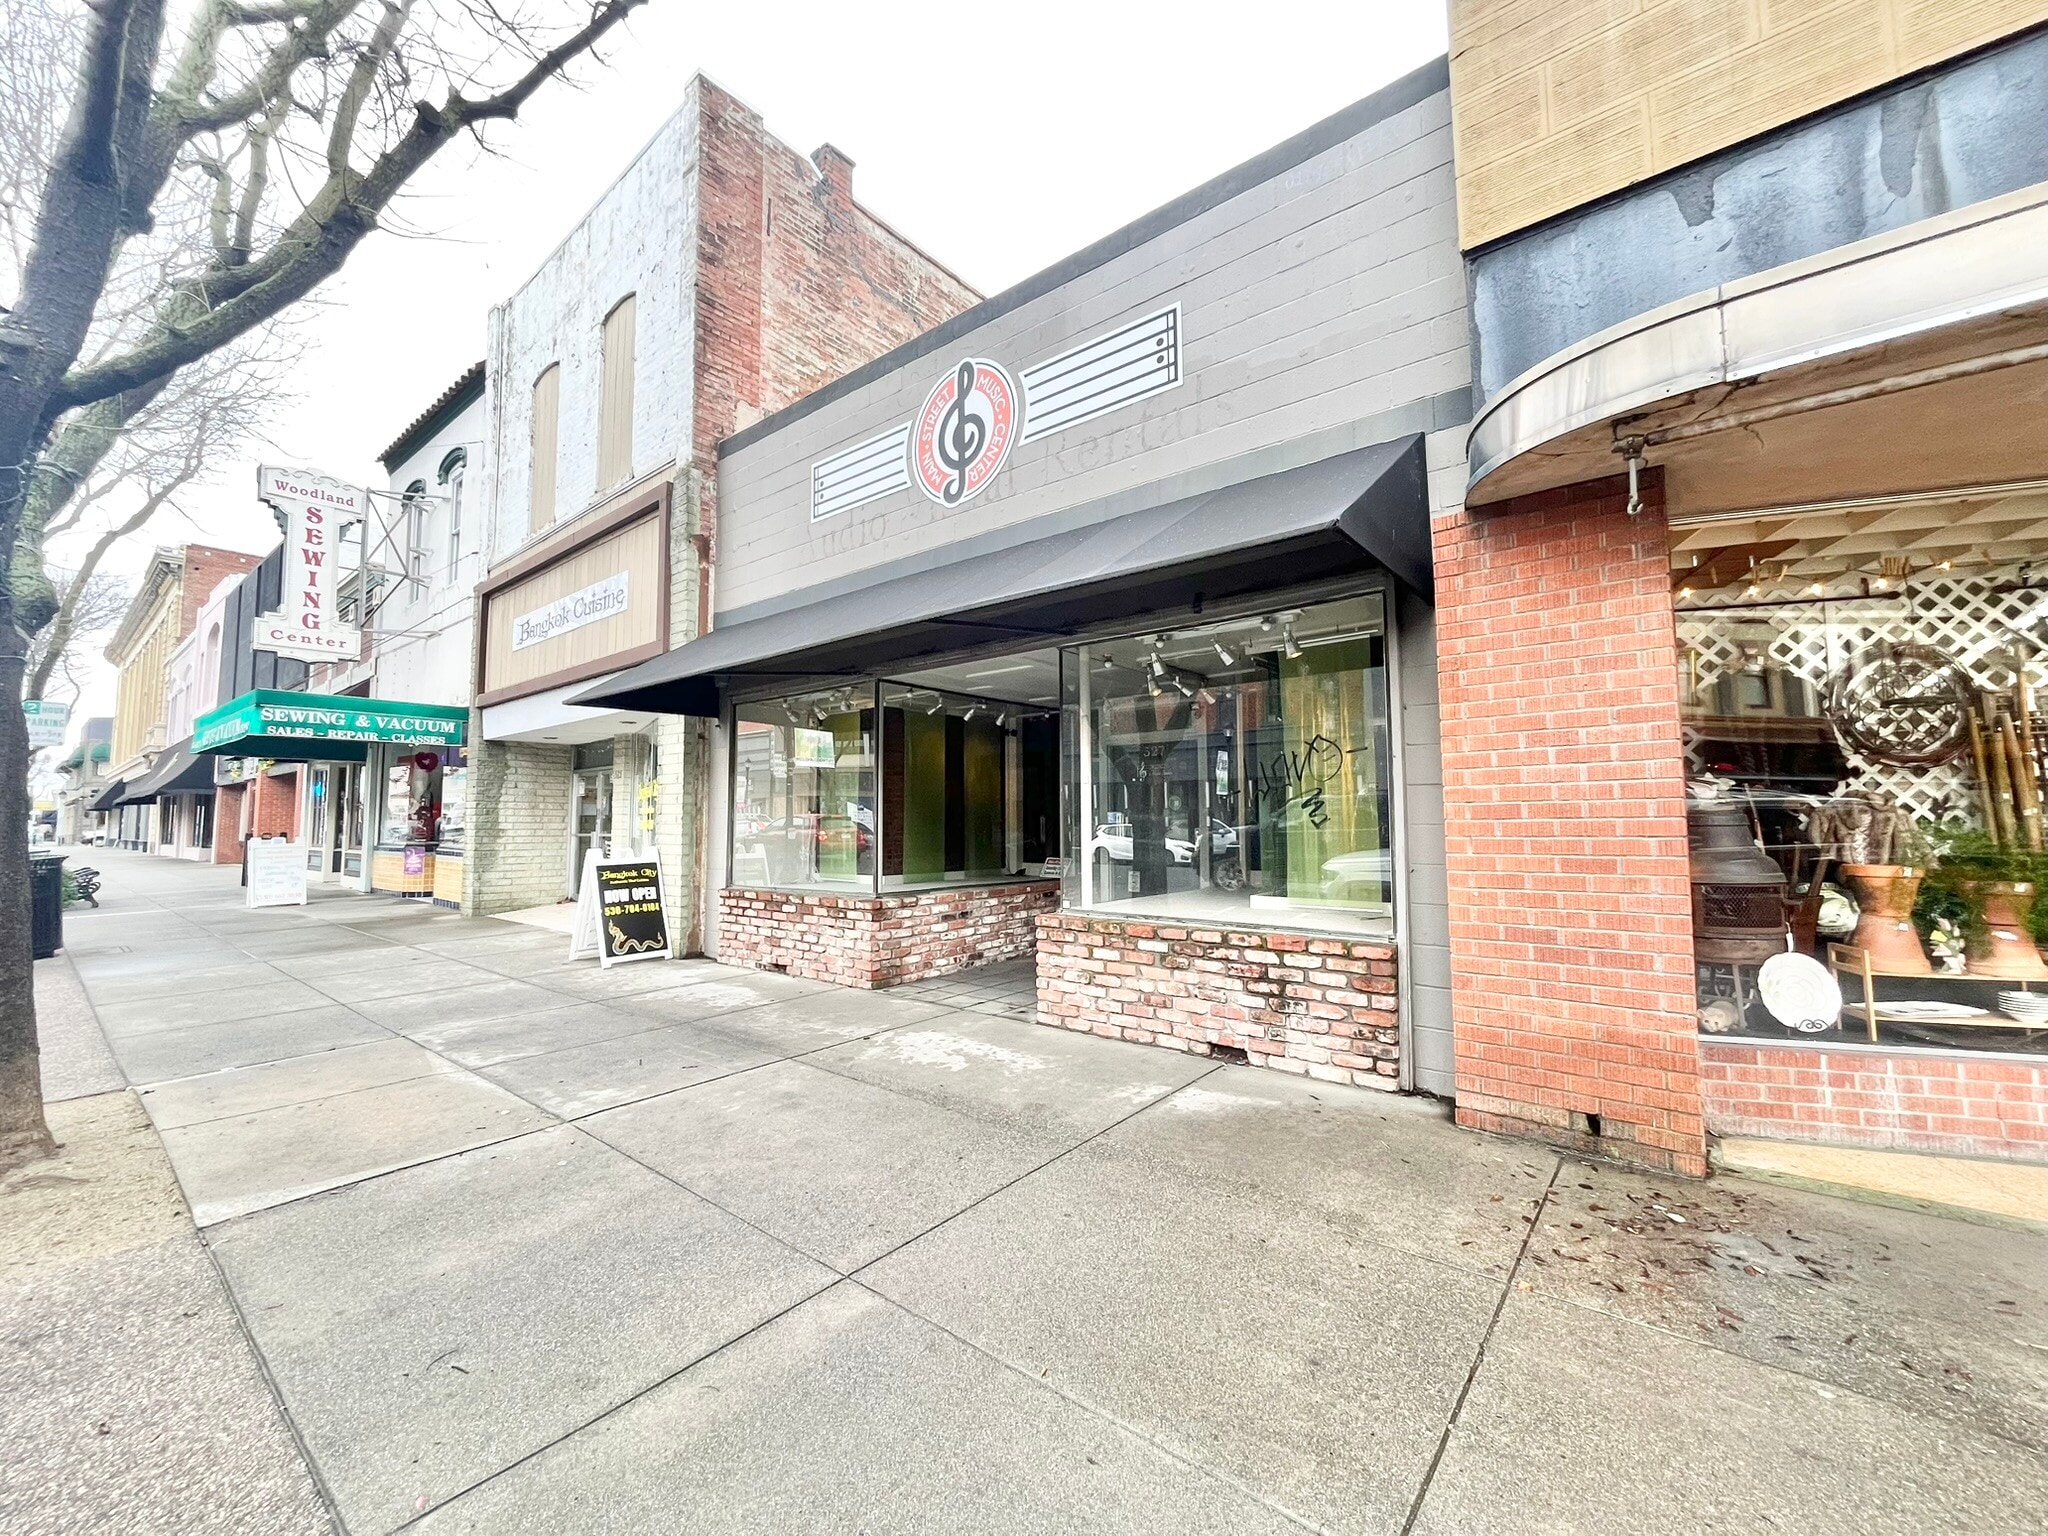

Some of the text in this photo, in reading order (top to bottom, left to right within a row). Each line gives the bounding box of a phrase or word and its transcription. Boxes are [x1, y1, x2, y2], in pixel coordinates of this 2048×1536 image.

[921, 374, 1006, 486] MAIN STREET MUSIC CENTER
[275, 479, 355, 508] Woodland
[301, 506, 327, 630] SEWING
[516, 587, 626, 645] Bangkok Cuisine
[270, 629, 348, 649] Center
[260, 707, 456, 734] SEWING & VACUUM
[267, 725, 314, 736] SALES
[327, 729, 379, 741] REPAIR
[391, 733, 446, 744] CLASSES
[600, 868, 657, 880] Bangkok City
[604, 887, 657, 904] NOW OPEN
